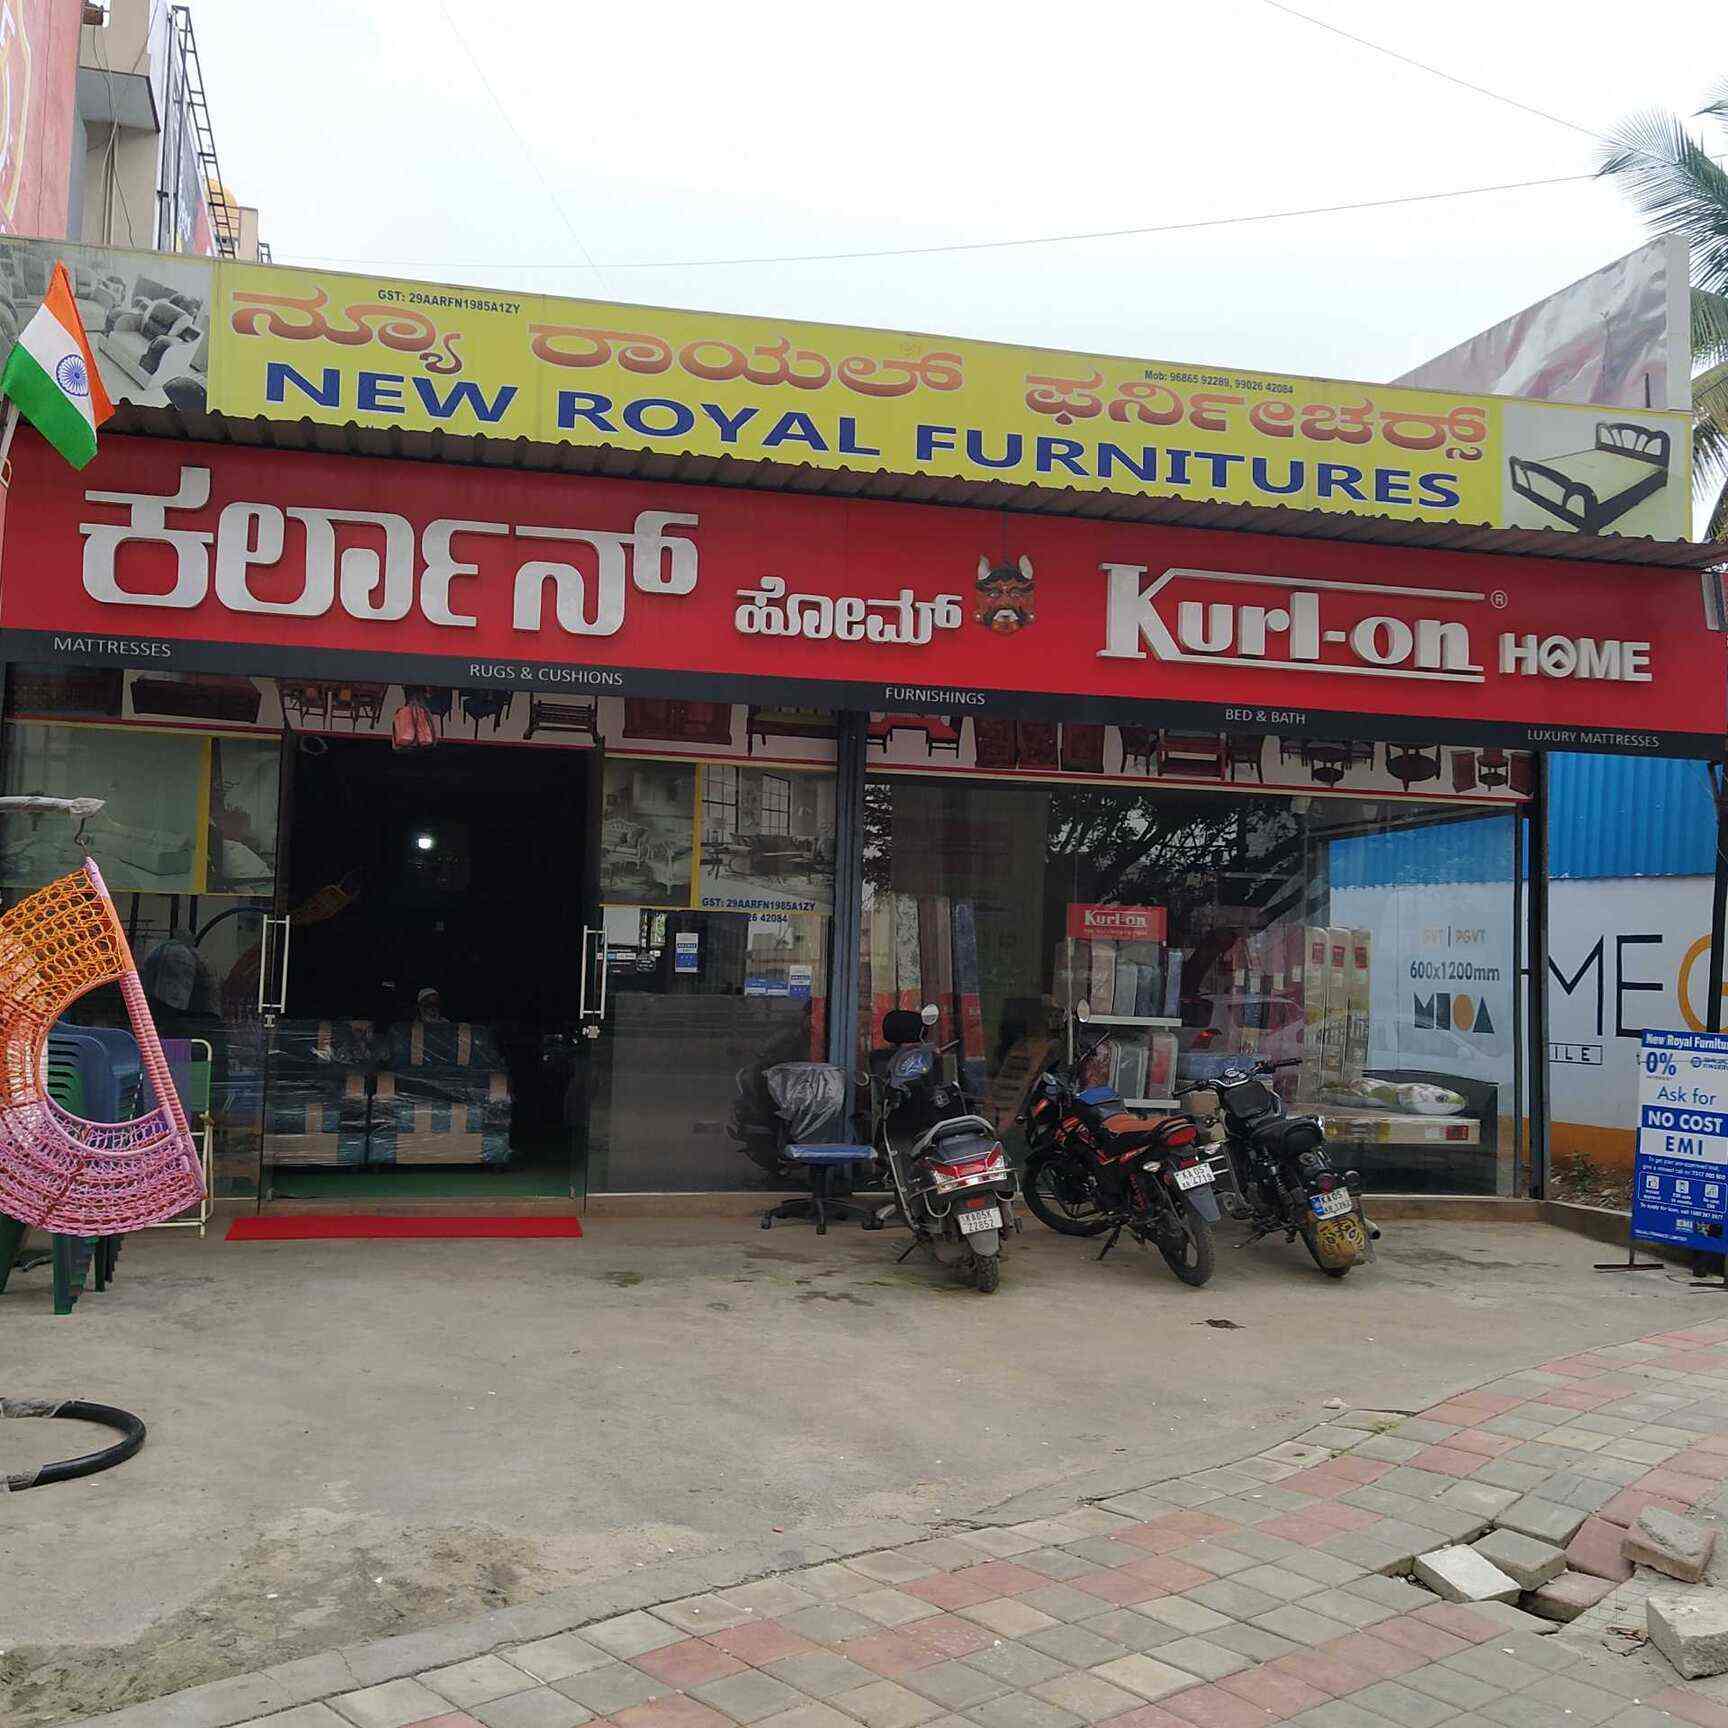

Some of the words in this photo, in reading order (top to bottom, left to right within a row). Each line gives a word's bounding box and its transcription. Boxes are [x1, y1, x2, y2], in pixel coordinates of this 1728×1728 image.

[377, 289, 405, 302] GST:
[408, 292, 521, 314] 29AARFN1985A1ZY
[528, 322, 964, 397] ರಾಯಲ್
[1144, 369, 1167, 382] Mob:
[265, 362, 518, 423] NEW
[556, 390, 881, 456] ROYAL
[915, 424, 1462, 509] FURNITURES
[734, 575, 963, 645] ಹೋಮ್
[1096, 562, 1486, 683] Kurl-on
[1499, 631, 1653, 682] HOME
[53, 636, 172, 658] MATTRESSES
[469, 663, 516, 682] RUGS
[519, 666, 533, 682] &
[537, 668, 624, 687] CUSHIONS
[884, 687, 986, 706] FURNISHINGS
[1224, 709, 1254, 723] BED
[1256, 711, 1266, 723] &
[1268, 711, 1307, 725] BATH
[1526, 728, 1575, 744] LUXURY
[1577, 731, 1661, 749] MATTRESSES
[1409, 960, 1501, 981] 600x1200mm
[1645, 1032, 1665, 1045] New
[1667, 1034, 1692, 1049] Royal
[1645, 1051, 1677, 1076] 0%
[1657, 1085, 1687, 1102] Ask
[1693, 1087, 1717, 1105] for
[1648, 1110, 1675, 1127] NO
[1679, 1114, 1723, 1134] COST
[1665, 1135, 1703, 1155] EMI
